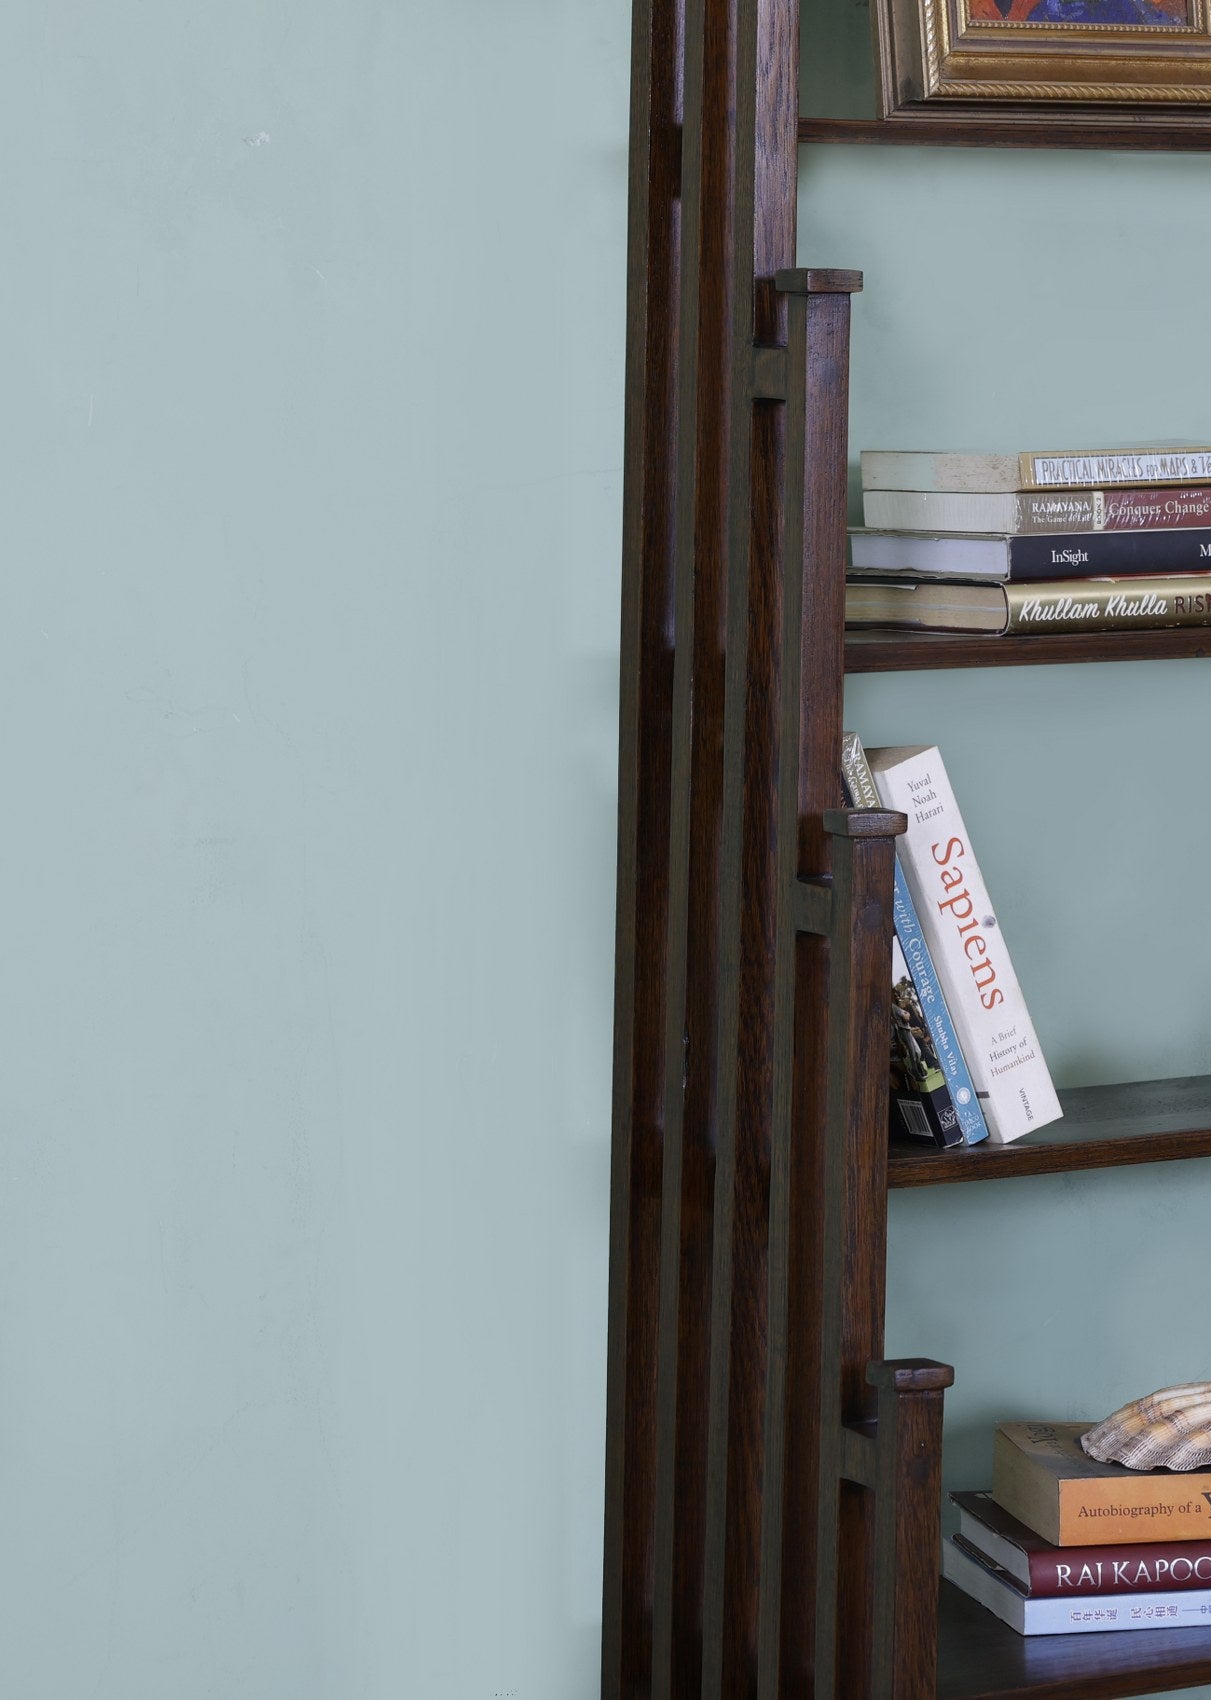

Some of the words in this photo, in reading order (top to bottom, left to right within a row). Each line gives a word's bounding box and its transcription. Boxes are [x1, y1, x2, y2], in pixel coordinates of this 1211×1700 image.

[1042, 459, 1094, 481] PRACTICAL
[1097, 457, 1144, 480] MIRACLES
[1191, 457, 1198, 474] &
[1032, 501, 1090, 512] RAMAYANA
[1109, 502, 1161, 520] Conquer
[1165, 500, 1209, 517] Change
[1032, 514, 1045, 524] The
[1047, 515, 1066, 523] Game
[1051, 549, 1089, 567] InSight
[1019, 597, 1100, 622] Khullam
[1105, 593, 1168, 618] Khulla
[907, 773, 932, 793] Yuval
[912, 789, 937, 808] Noah
[915, 802, 945, 824] Harari
[931, 837, 1004, 1010] Sapiens
[895, 900, 916, 933] with
[909, 938, 935, 1003] Courage
[933, 1015, 949, 1051] Shubha
[946, 1051, 958, 1077] Vilas
[992, 1037, 998, 1045] A
[1000, 1025, 1017, 1042] Brief
[989, 1043, 1018, 1062] History
[1019, 1036, 1028, 1048] of
[990, 1050, 1036, 1077] Humankind
[1019, 1087, 1034, 1121] VINTAGE
[1078, 1502, 1174, 1518] Autobiography
[1178, 1500, 1193, 1514] of
[1195, 1504, 1202, 1513] a
[1056, 1562, 1103, 1588] RAJ
[1070, 1608, 1118, 1622] 百年华诞
[1130, 1605, 1179, 1619] 民心相通
